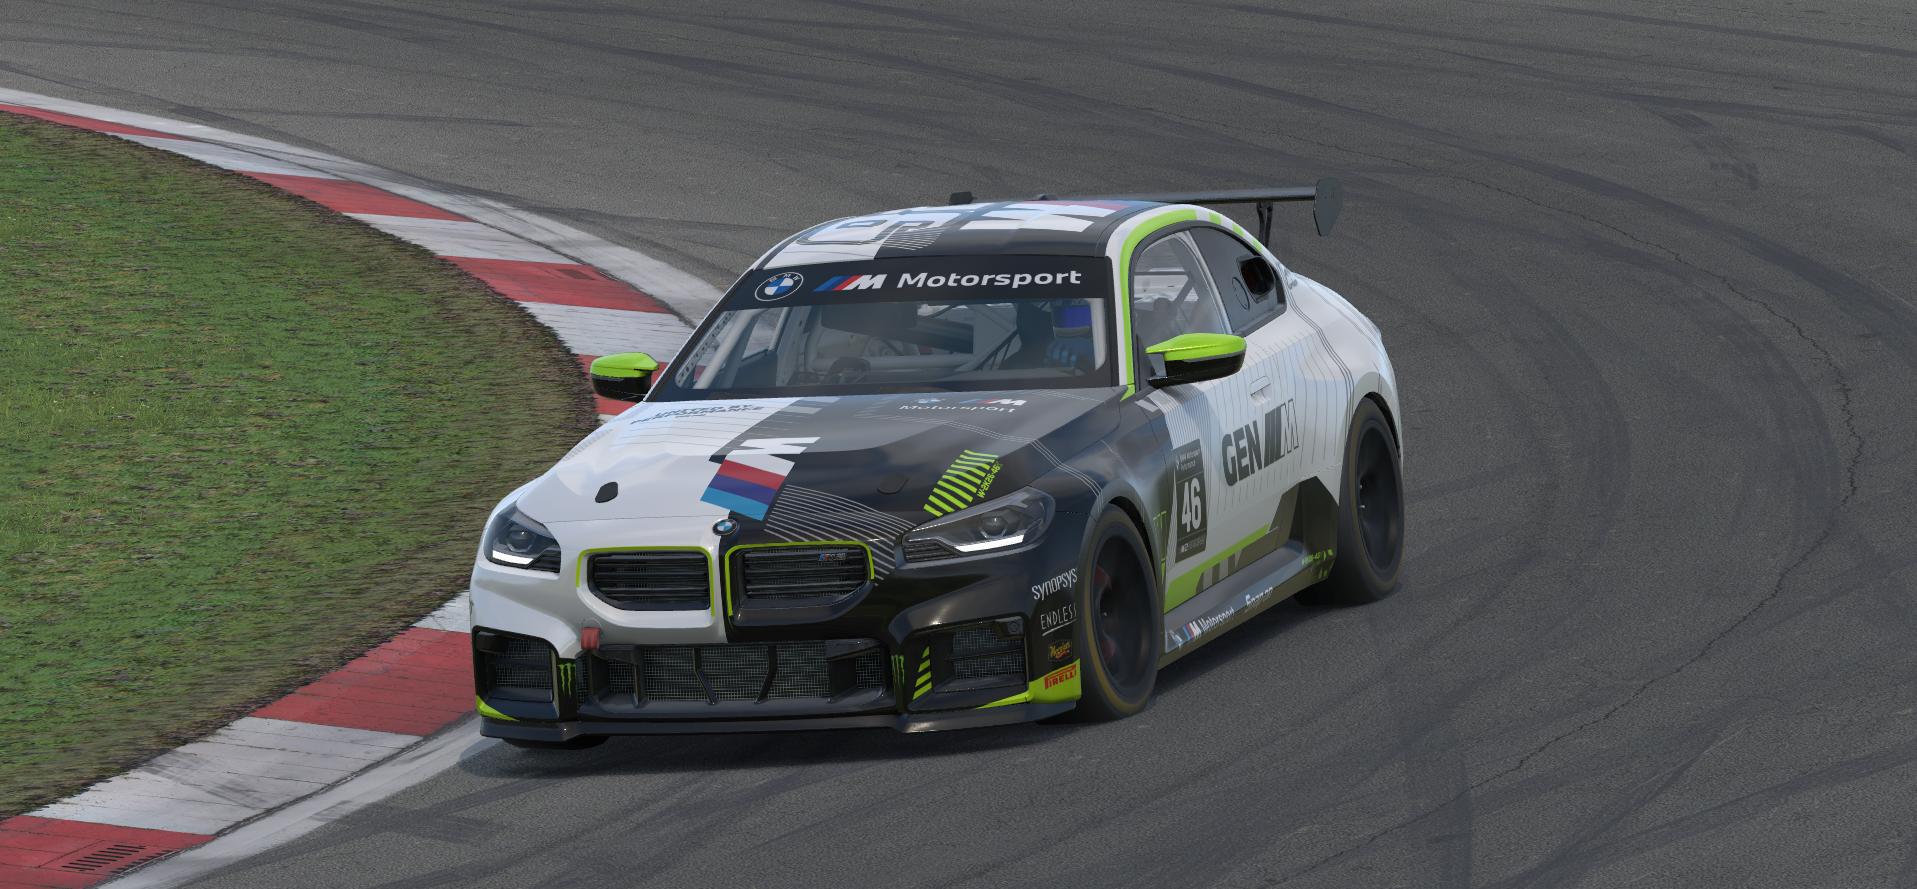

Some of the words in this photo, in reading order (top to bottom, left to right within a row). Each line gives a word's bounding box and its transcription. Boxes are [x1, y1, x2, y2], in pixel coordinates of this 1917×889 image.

[897, 270, 1082, 288] Motorsport
[1221, 420, 1263, 487] GEN
[1181, 477, 1202, 533] 46
[1031, 568, 1078, 600] SYNOPSYS
[1044, 663, 1077, 689] PIRELLI
